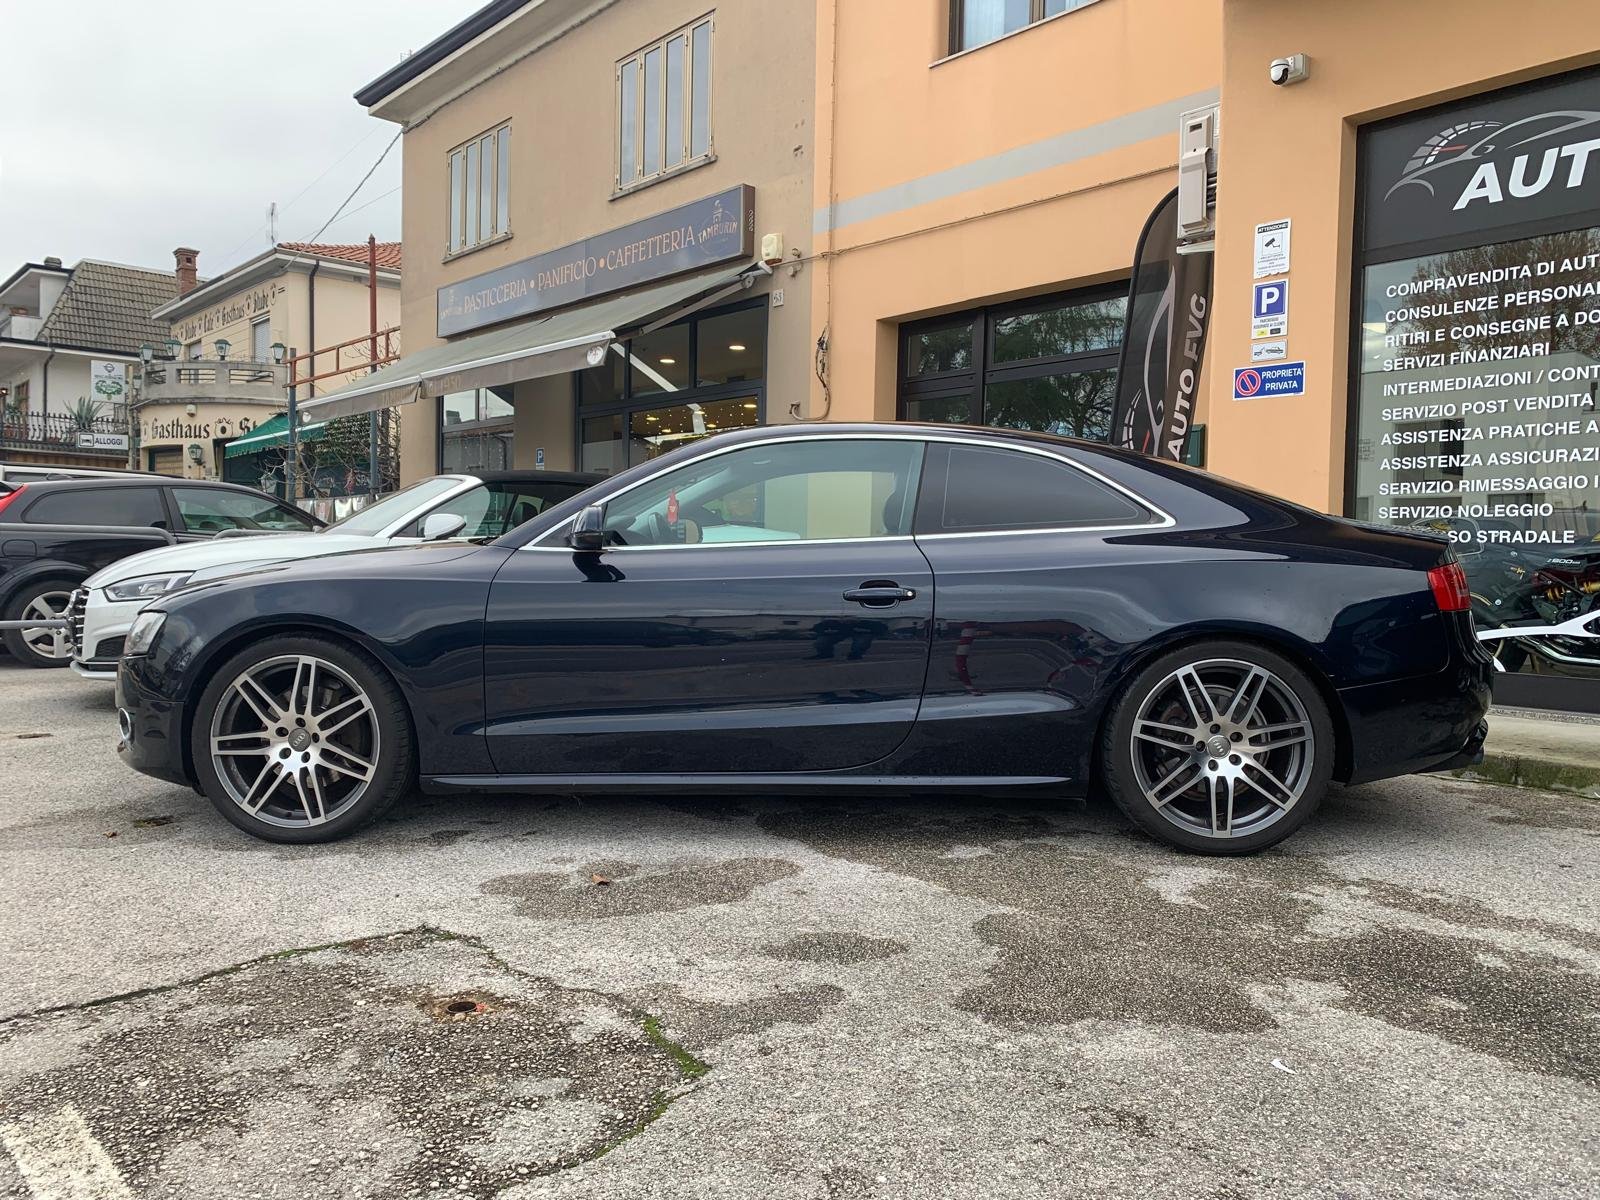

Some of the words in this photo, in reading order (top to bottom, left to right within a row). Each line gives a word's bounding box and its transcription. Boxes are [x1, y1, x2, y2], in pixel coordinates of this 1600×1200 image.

[464, 279, 527, 313] PASTICCERIA
[538, 256, 597, 291] PANIFICIO
[606, 225, 697, 271] CAFFETTERIA
[1386, 263, 1531, 299] COMPRAVENDITA
[1537, 260, 1556, 276] DI
[1261, 287, 1280, 314] P
[1385, 295, 1499, 323] CONSULENZE
[1384, 330, 1430, 349] RITIRI
[1435, 328, 1446, 342] E
[1450, 316, 1551, 340] CONSEGNE
[1556, 314, 1570, 328] A
[1383, 353, 1445, 372] SERVIZI
[1450, 342, 1550, 365] FINANZIARI
[1168, 368, 1194, 461] AUTO
[1184, 293, 1207, 362] FVG
[1265, 381, 1298, 391] PRIVATA
[1383, 371, 1532, 397] INTERMEDIAZIONI
[1382, 403, 1456, 421] SERVIZIO
[1461, 399, 1509, 416] POST
[1514, 392, 1594, 413] VENDITA
[152, 417, 210, 439] Gasthaus
[1381, 427, 1483, 446] ASSISTENZA
[1489, 421, 1581, 440] PRATICHE
[1585, 420, 1600, 433] A
[95, 437, 123, 446] ALLOGGI
[537, 450, 543, 462] P
[1380, 454, 1483, 471] ASSISTENZA
[1487, 447, 1600, 467] ASSICURAZI
[1379, 479, 1454, 496] SERVIZIO
[1458, 474, 1588, 493] RIMESSAGGIO
[1378, 506, 1453, 519] SERVIZIO
[1458, 503, 1553, 518] NOLEGGIO
[1476, 530, 1575, 544] STRADALE
